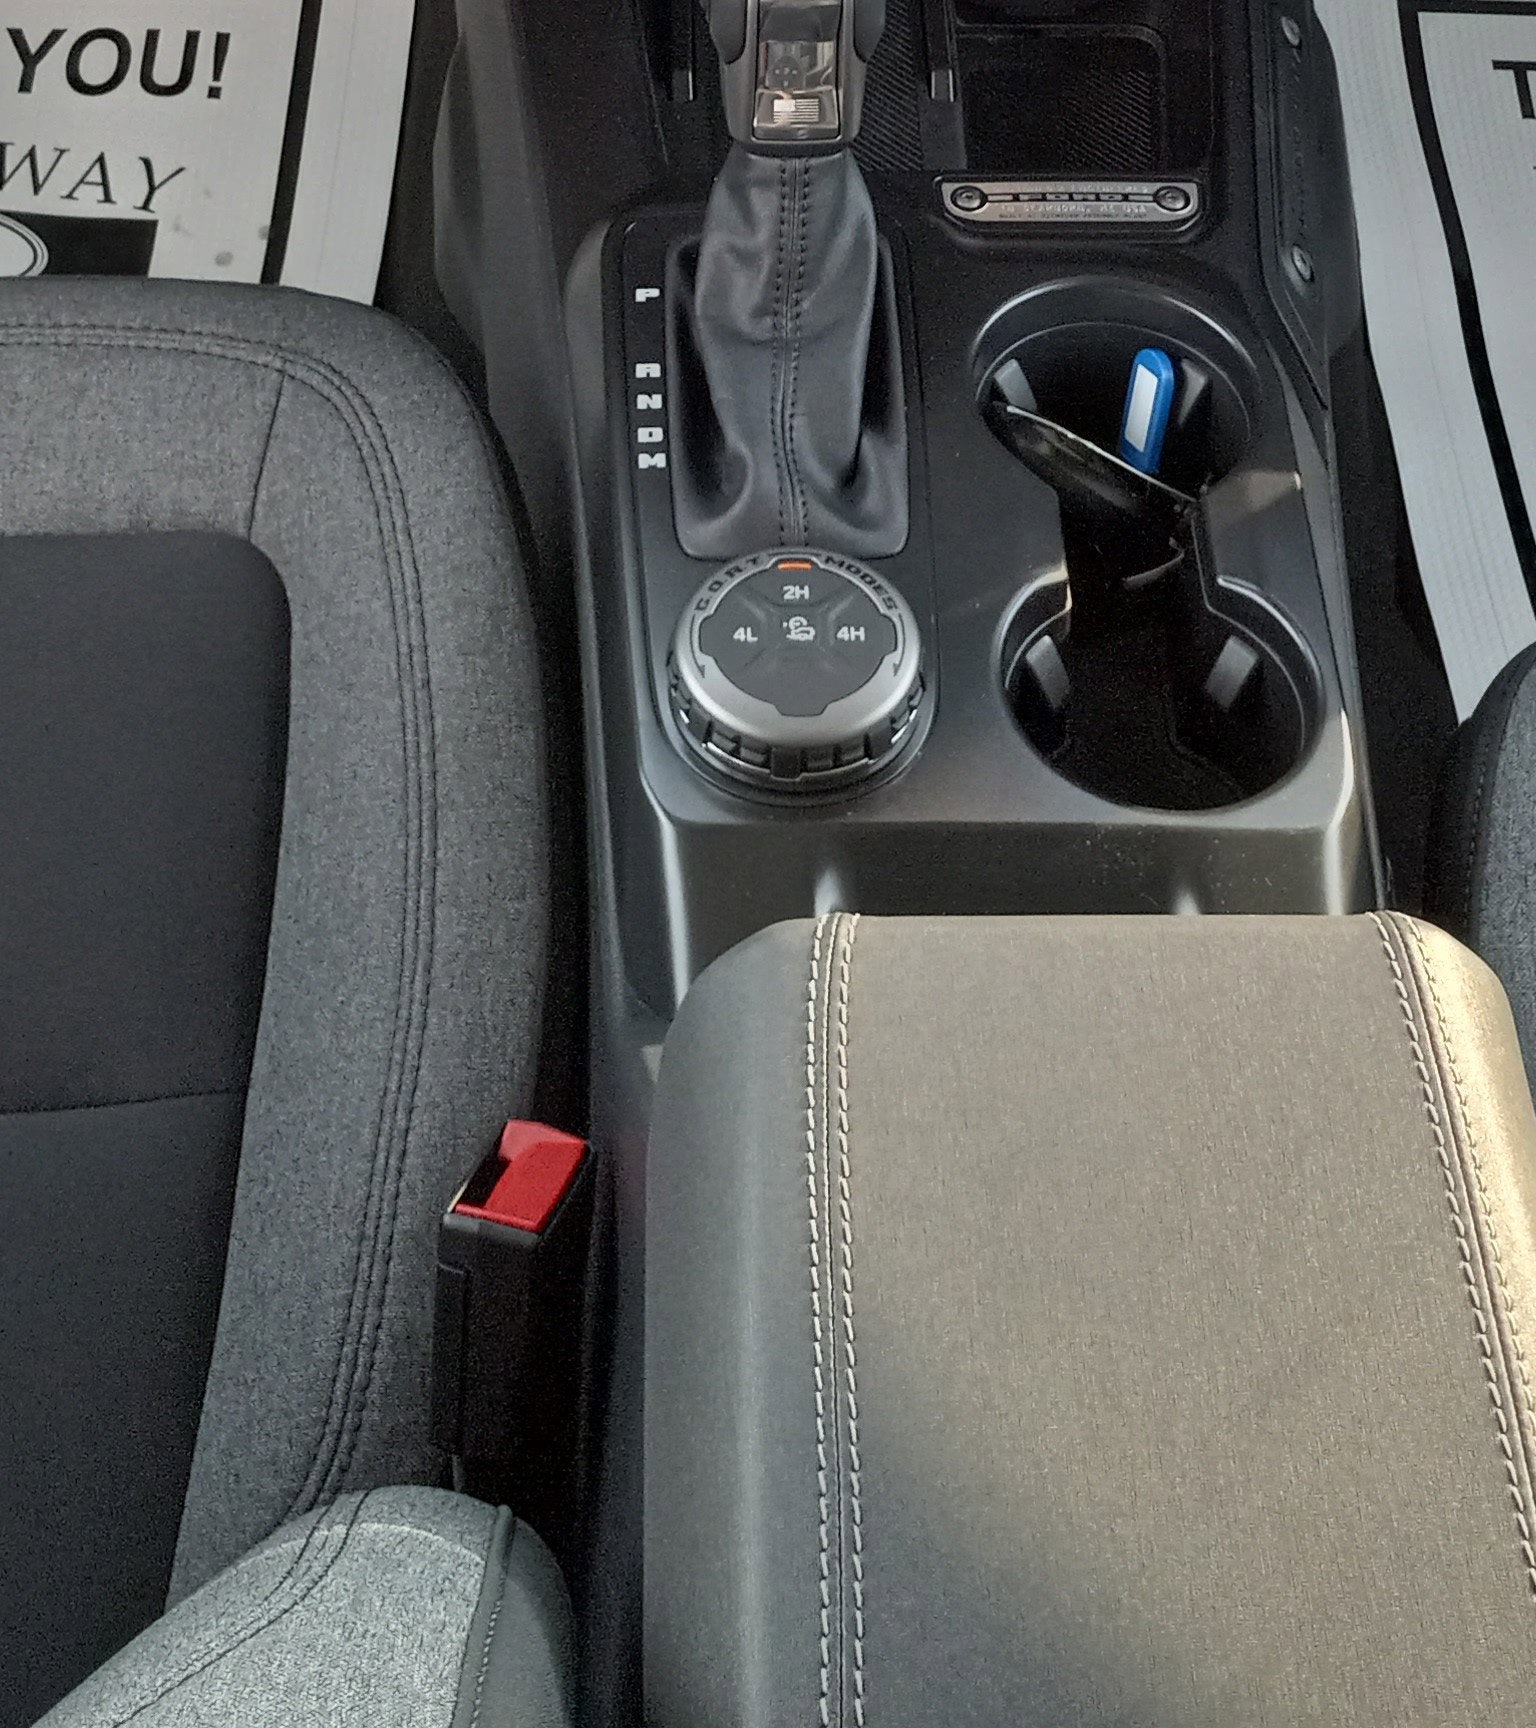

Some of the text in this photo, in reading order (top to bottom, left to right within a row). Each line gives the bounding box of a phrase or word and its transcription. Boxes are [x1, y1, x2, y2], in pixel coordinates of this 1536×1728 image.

[6, 27, 230, 100] YOU!
[635, 288, 660, 302] P
[635, 363, 661, 378] R
[636, 394, 662, 409] N
[637, 427, 663, 443] D
[638, 453, 666, 469] M
[825, 555, 898, 610] MODES
[783, 585, 809, 600] 2H
[733, 627, 758, 642] 4L
[837, 626, 865, 641] 4H
